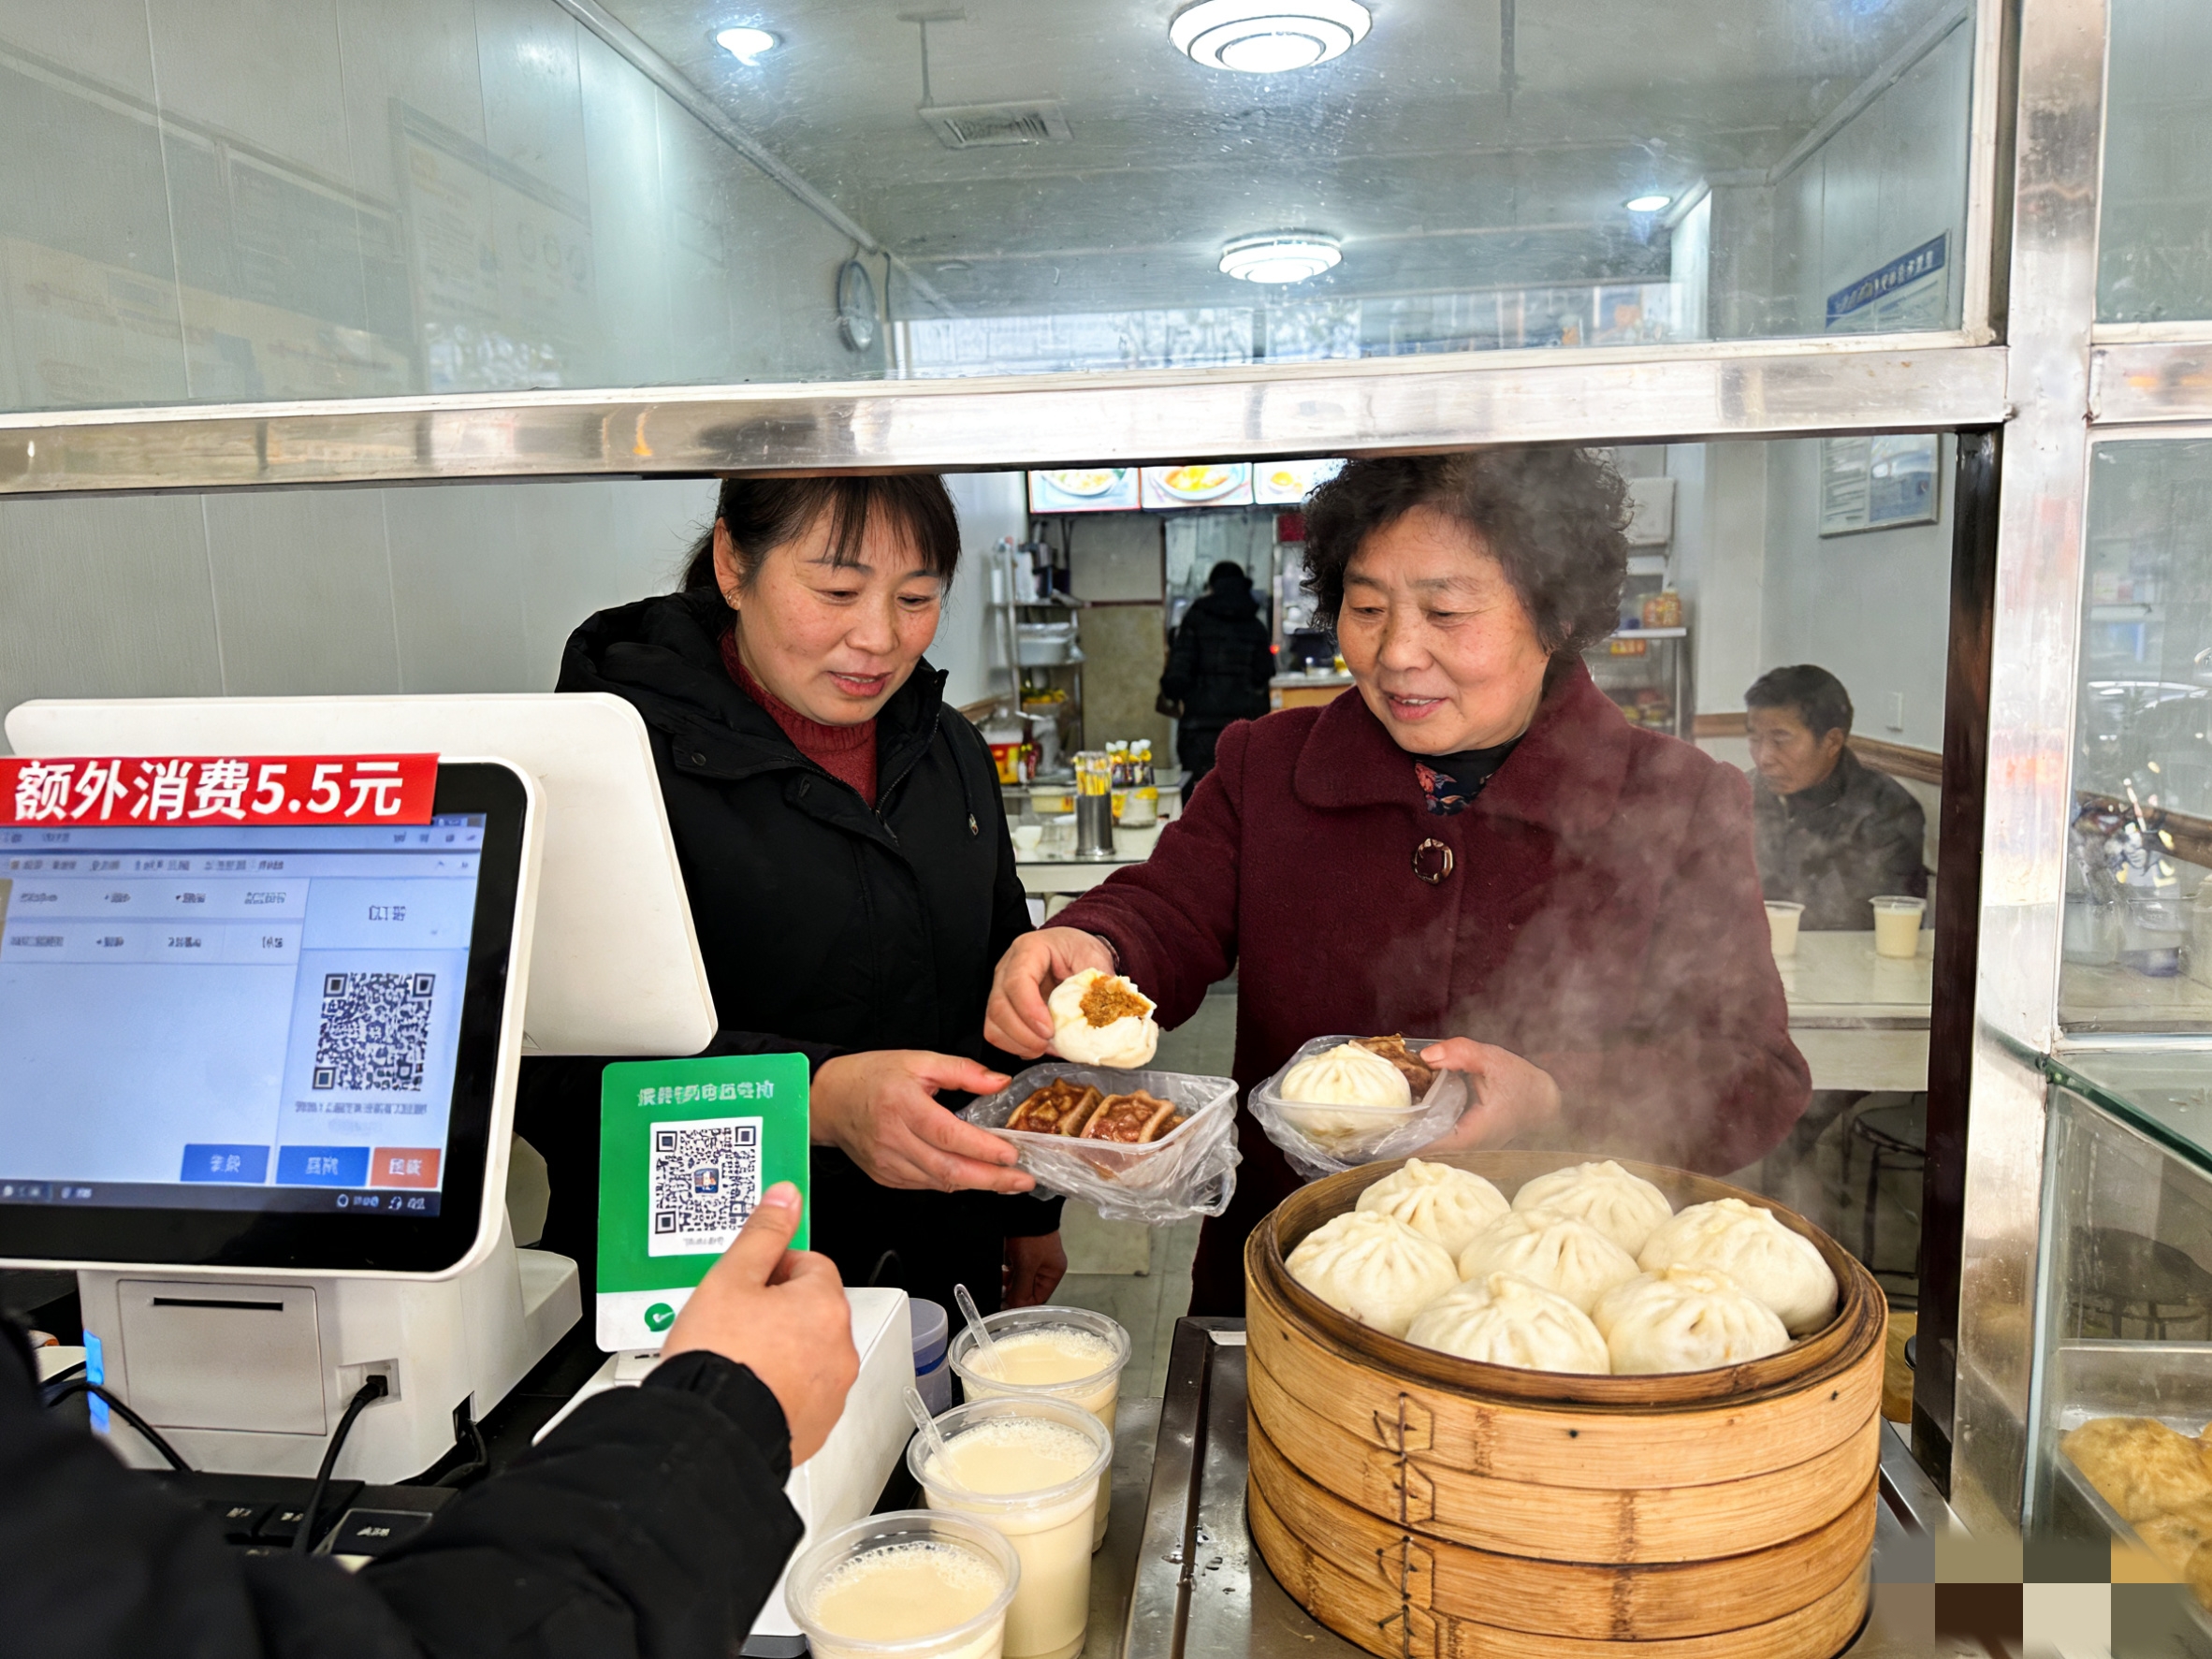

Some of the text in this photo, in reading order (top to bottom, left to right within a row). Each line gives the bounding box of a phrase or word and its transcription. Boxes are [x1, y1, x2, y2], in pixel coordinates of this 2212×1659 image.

[14, 759, 403, 821] 额外消费5.5元
